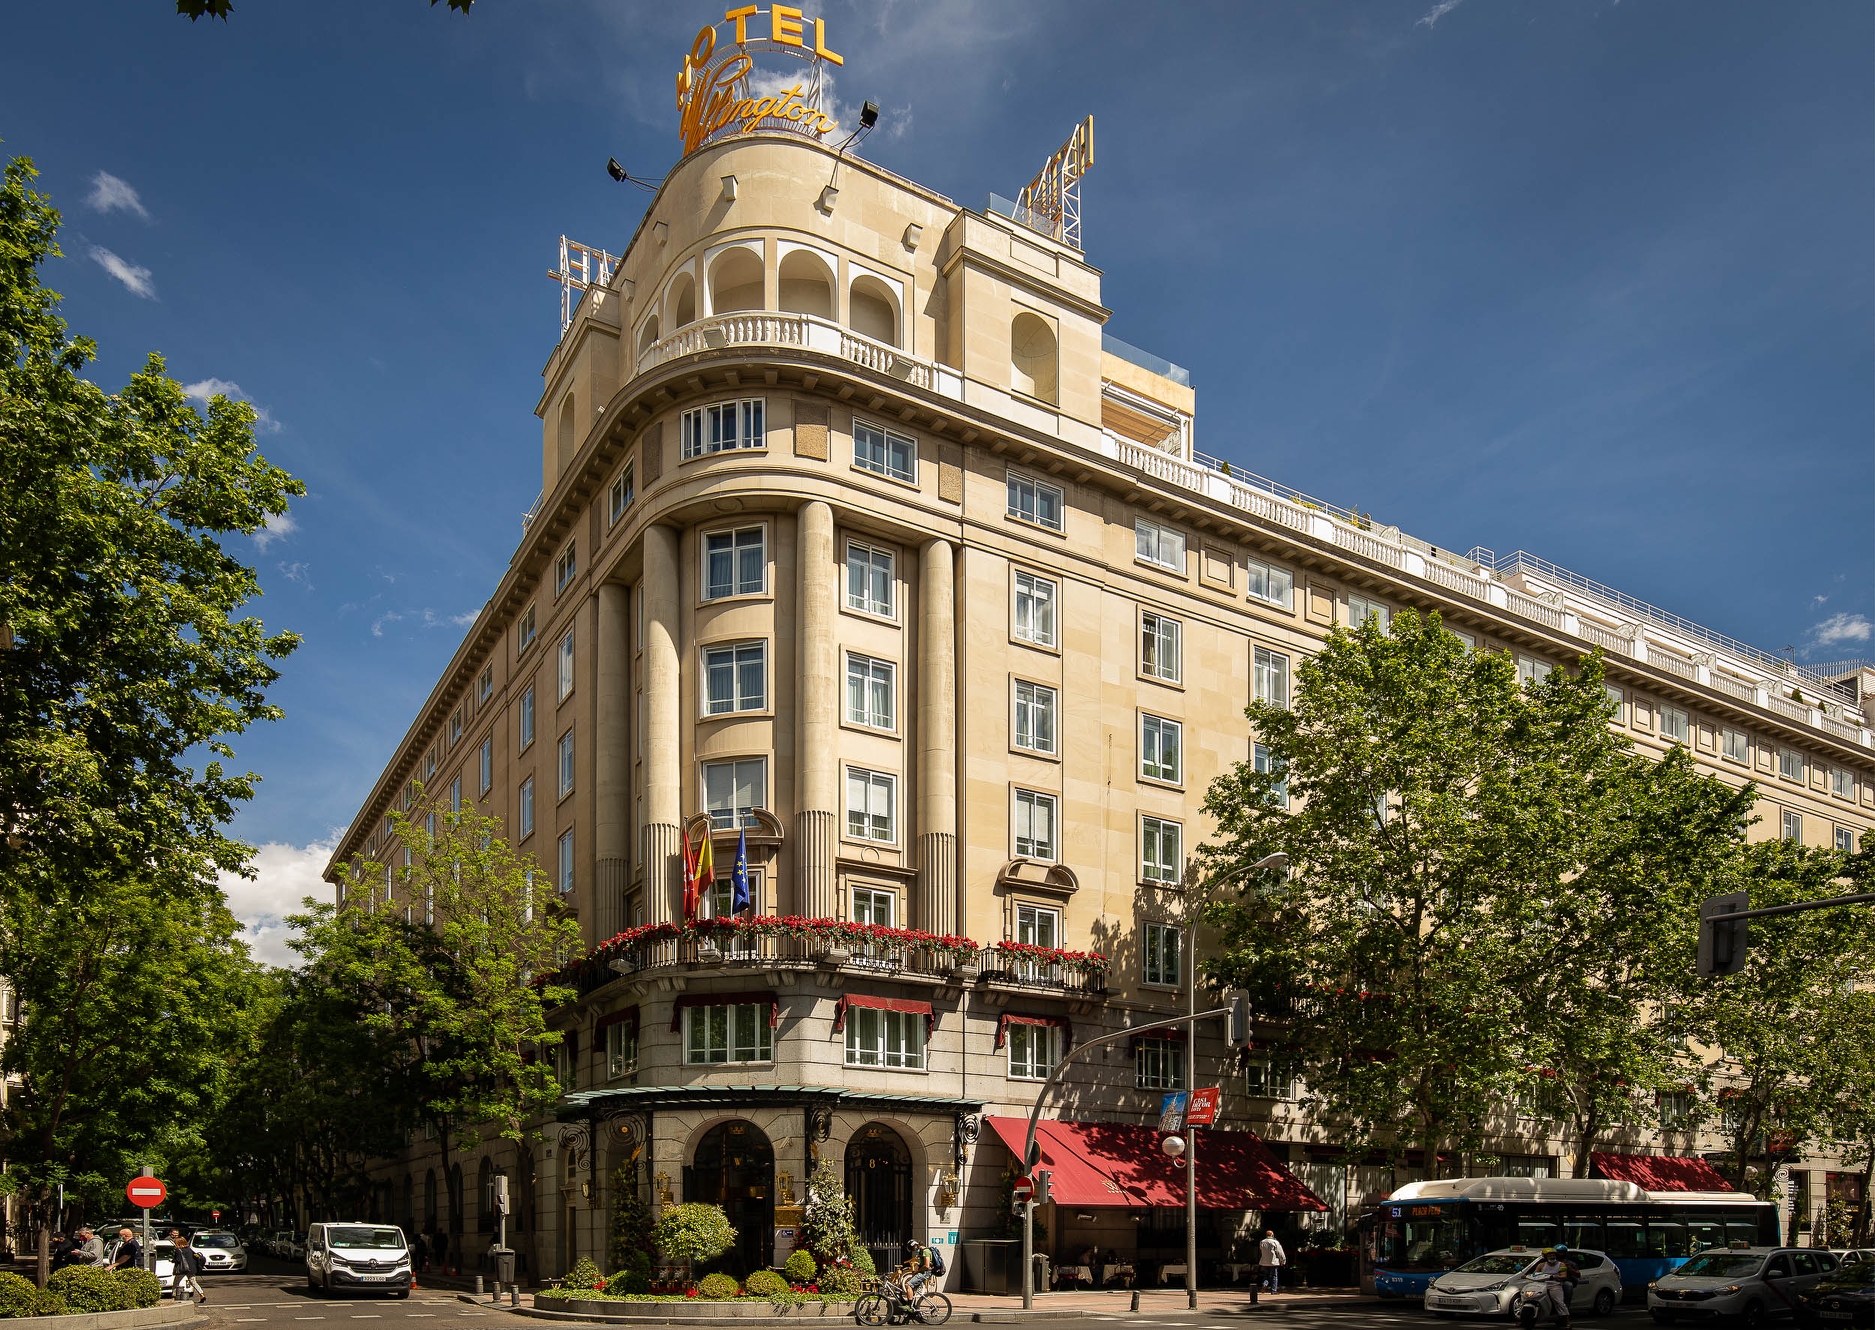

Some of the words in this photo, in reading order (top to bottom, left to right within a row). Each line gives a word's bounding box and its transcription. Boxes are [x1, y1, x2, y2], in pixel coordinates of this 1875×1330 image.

[676, 3, 844, 111] HOTEL
[869, 1158, 876, 1169] 8
[1391, 1207, 1402, 1218] 51
[1412, 1206, 1428, 1216] PLAZA
